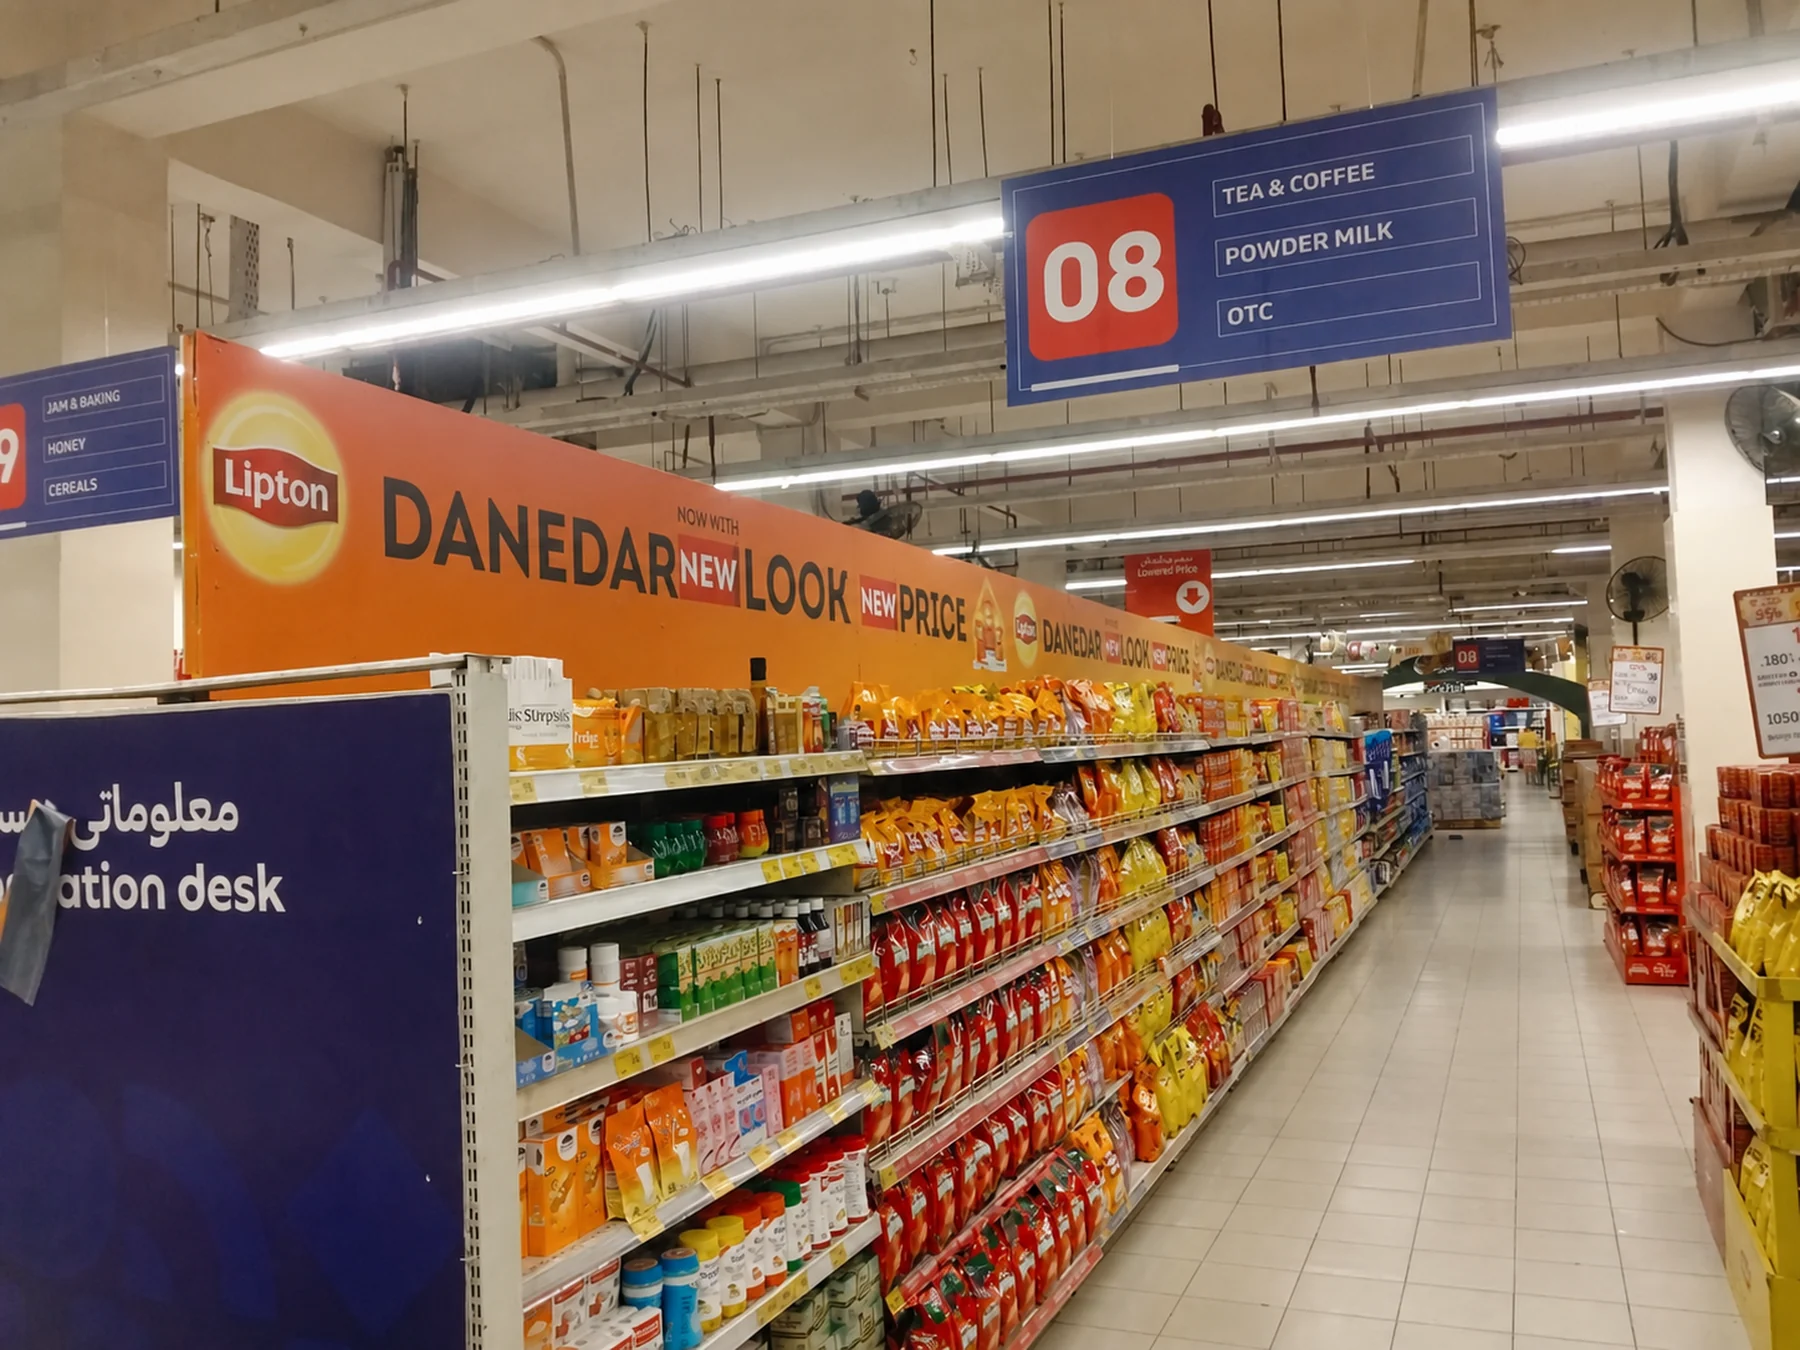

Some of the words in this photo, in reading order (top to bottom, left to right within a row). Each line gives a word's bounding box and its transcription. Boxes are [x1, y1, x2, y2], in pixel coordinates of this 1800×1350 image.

[1222, 183, 1264, 205] TEA
[1268, 178, 1285, 198] &
[1289, 162, 1377, 194] COFFEE
[1224, 231, 1330, 266] POWDER
[1333, 220, 1394, 248] MILK
[1042, 230, 1166, 324] 08
[1226, 301, 1274, 326] OTC
[46, 400, 68, 415] JAM
[69, 396, 79, 410] &
[79, 389, 121, 408] BAKING
[47, 437, 87, 456] HONEY
[48, 477, 98, 497] CEREALS
[224, 458, 330, 512] Lipton
[677, 506, 707, 528] NOW
[709, 513, 739, 537] WITH
[383, 475, 679, 600] DANEDAR
[679, 548, 738, 592] NEW
[745, 547, 851, 624] LOOK
[860, 586, 896, 620] NEW
[899, 584, 967, 642] PRICE
[1137, 565, 1174, 577] Lowered
[1175, 565, 1198, 574] Price
[1043, 618, 1103, 661] DANEDAR
[1120, 634, 1151, 669] LOOK
[1166, 645, 1190, 674] PRICE
[1458, 650, 1477, 663] 08
[178, 863, 286, 912] desk
